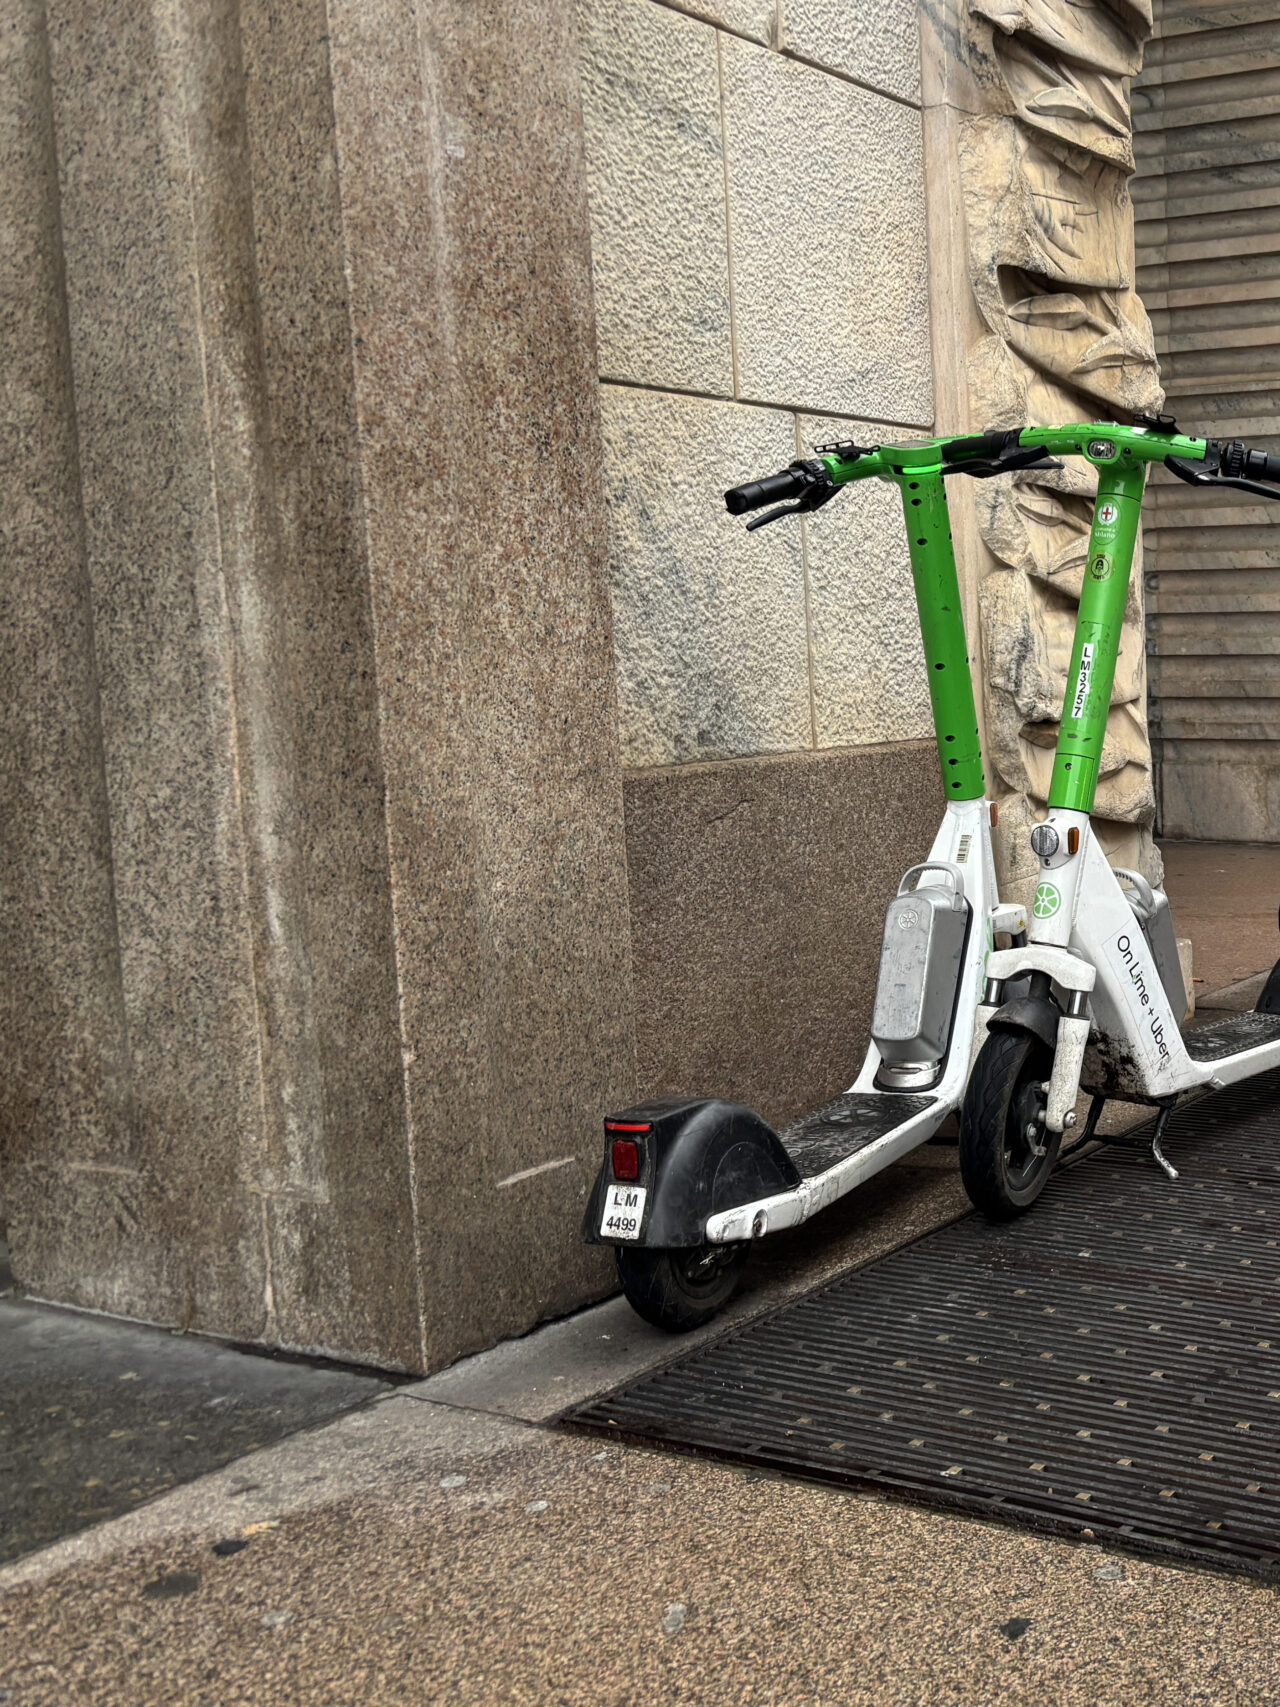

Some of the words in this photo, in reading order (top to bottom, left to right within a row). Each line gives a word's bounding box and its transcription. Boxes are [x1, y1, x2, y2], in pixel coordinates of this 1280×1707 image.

[1117, 935, 1134, 965] On
[1128, 961, 1150, 1007] Lime
[1147, 1007, 1155, 1017] +
[1150, 1016, 1171, 1060] Uber
[606, 1215, 637, 1232] 4499
